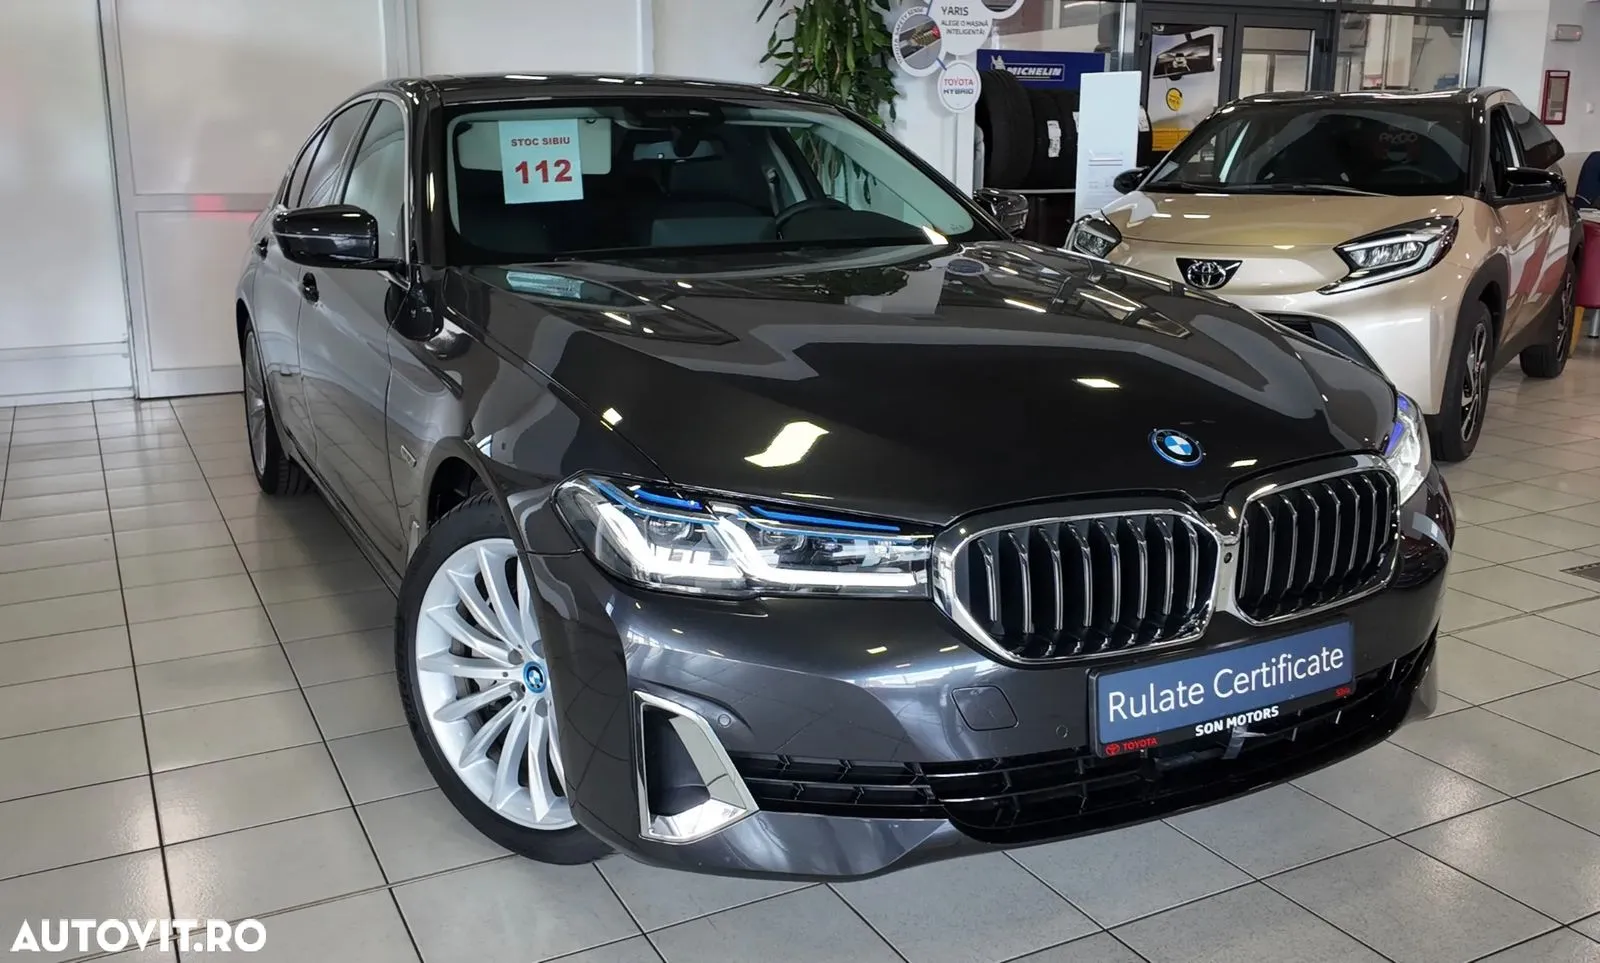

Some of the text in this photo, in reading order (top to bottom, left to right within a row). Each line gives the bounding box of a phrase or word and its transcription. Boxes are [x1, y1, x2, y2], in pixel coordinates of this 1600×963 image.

[940, 6, 969, 16] YARIS
[1007, 67, 1062, 76] MICHELIN
[944, 78, 974, 86] TOYOTA
[511, 137, 571, 147] STOC SIBIU
[515, 159, 573, 184] 112
[1108, 646, 1344, 723] Rulate Certificate
[1195, 705, 1280, 737] SON MOTORS
[1123, 736, 1158, 750] TOYOTA
